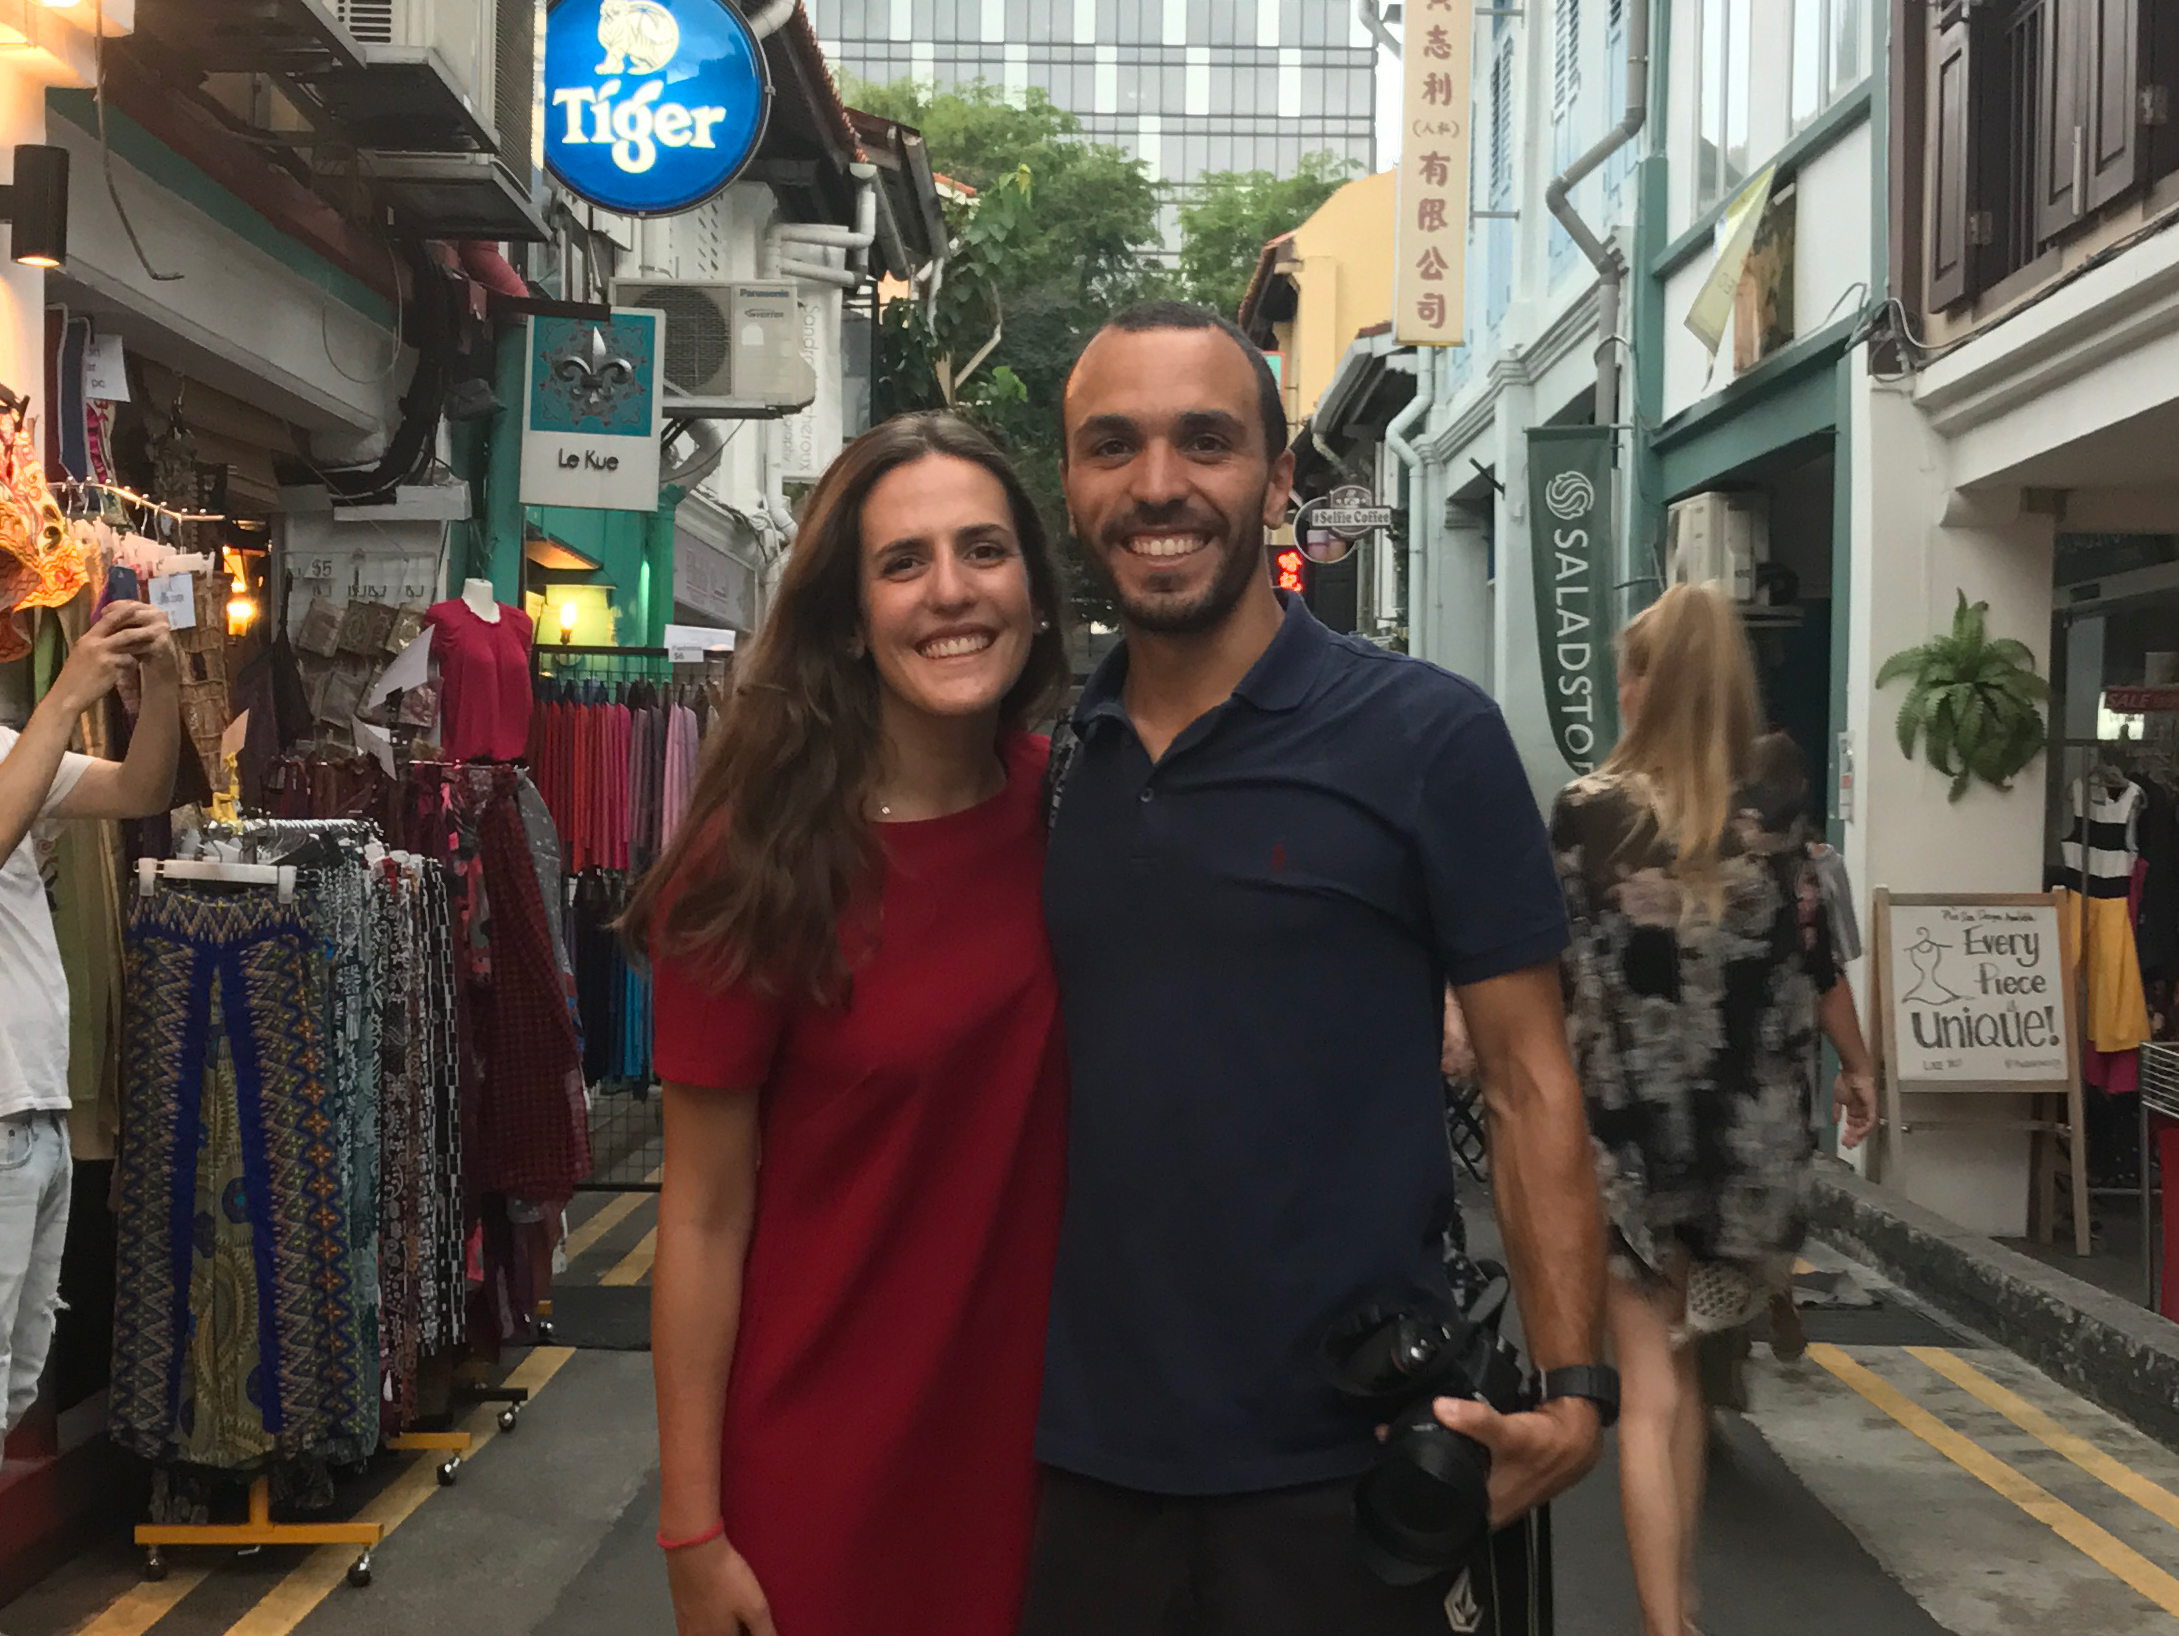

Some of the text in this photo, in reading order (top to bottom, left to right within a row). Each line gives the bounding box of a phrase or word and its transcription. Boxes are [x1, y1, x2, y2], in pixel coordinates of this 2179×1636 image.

[552, 79, 727, 174] Tiger
[558, 447, 620, 471] Le Kue
[1353, 510, 1389, 524] Coffee
[311, 558, 332, 577] $5
[1963, 924, 2040, 967] Every
[1973, 962, 2047, 995] Piece
